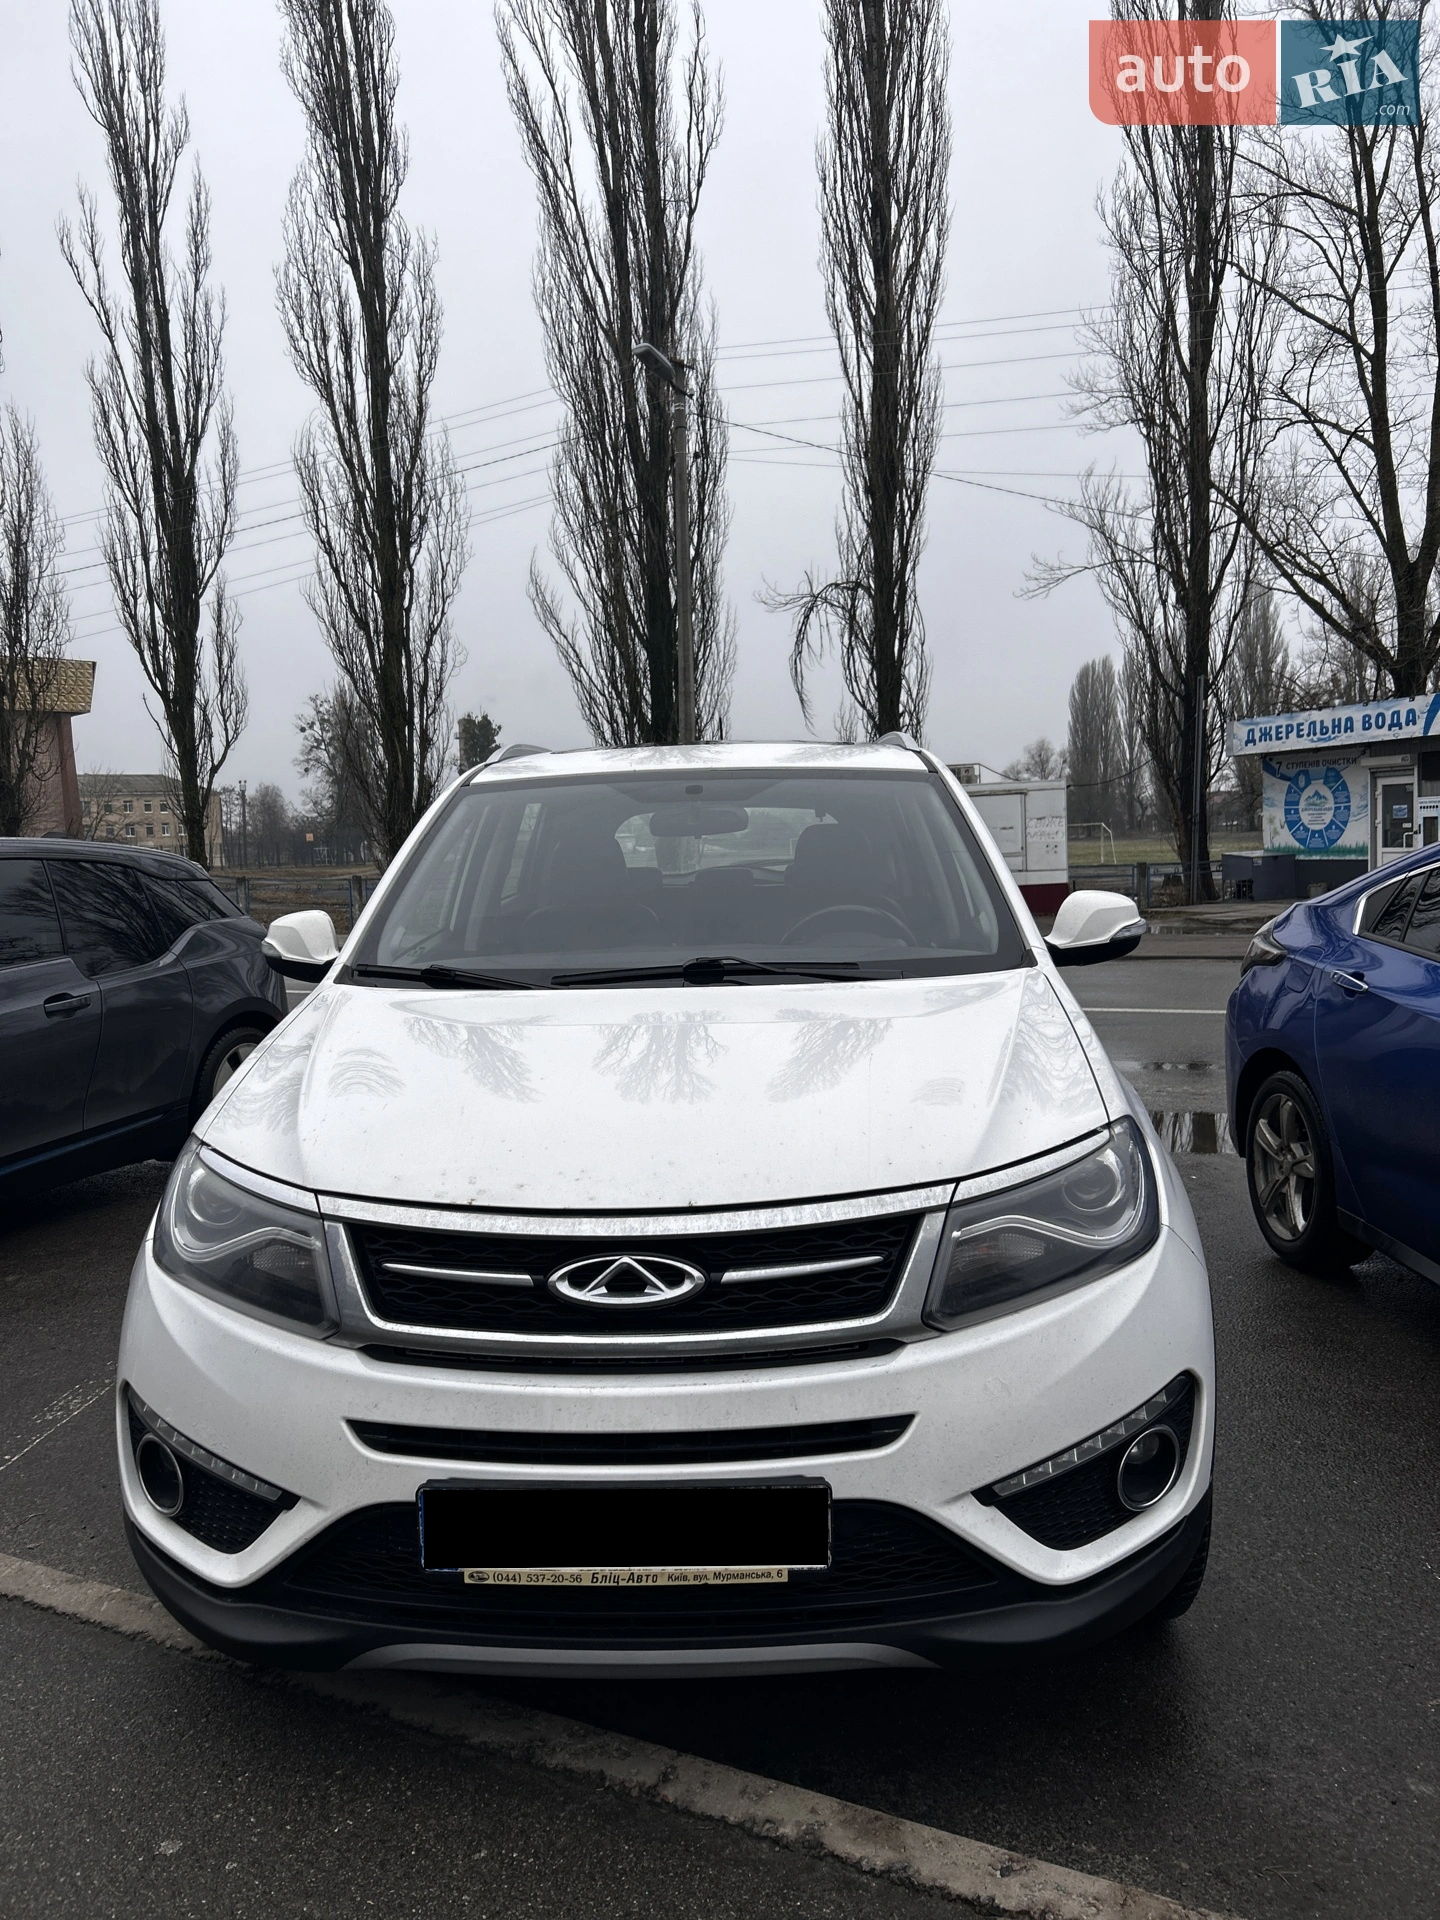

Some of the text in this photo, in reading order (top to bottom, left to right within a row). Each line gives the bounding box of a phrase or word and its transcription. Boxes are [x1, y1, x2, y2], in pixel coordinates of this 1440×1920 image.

[1244, 707, 1418, 747] ДЖЕРЕЛЬНА ВОДА
[1275, 757, 1357, 777] 7 СТУПЕНІВ ОЧИСТКИ
[492, 1569, 783, 1585] (044) 537-20-56 Бліц-Авто Київ, вул. Мурманська, 6
